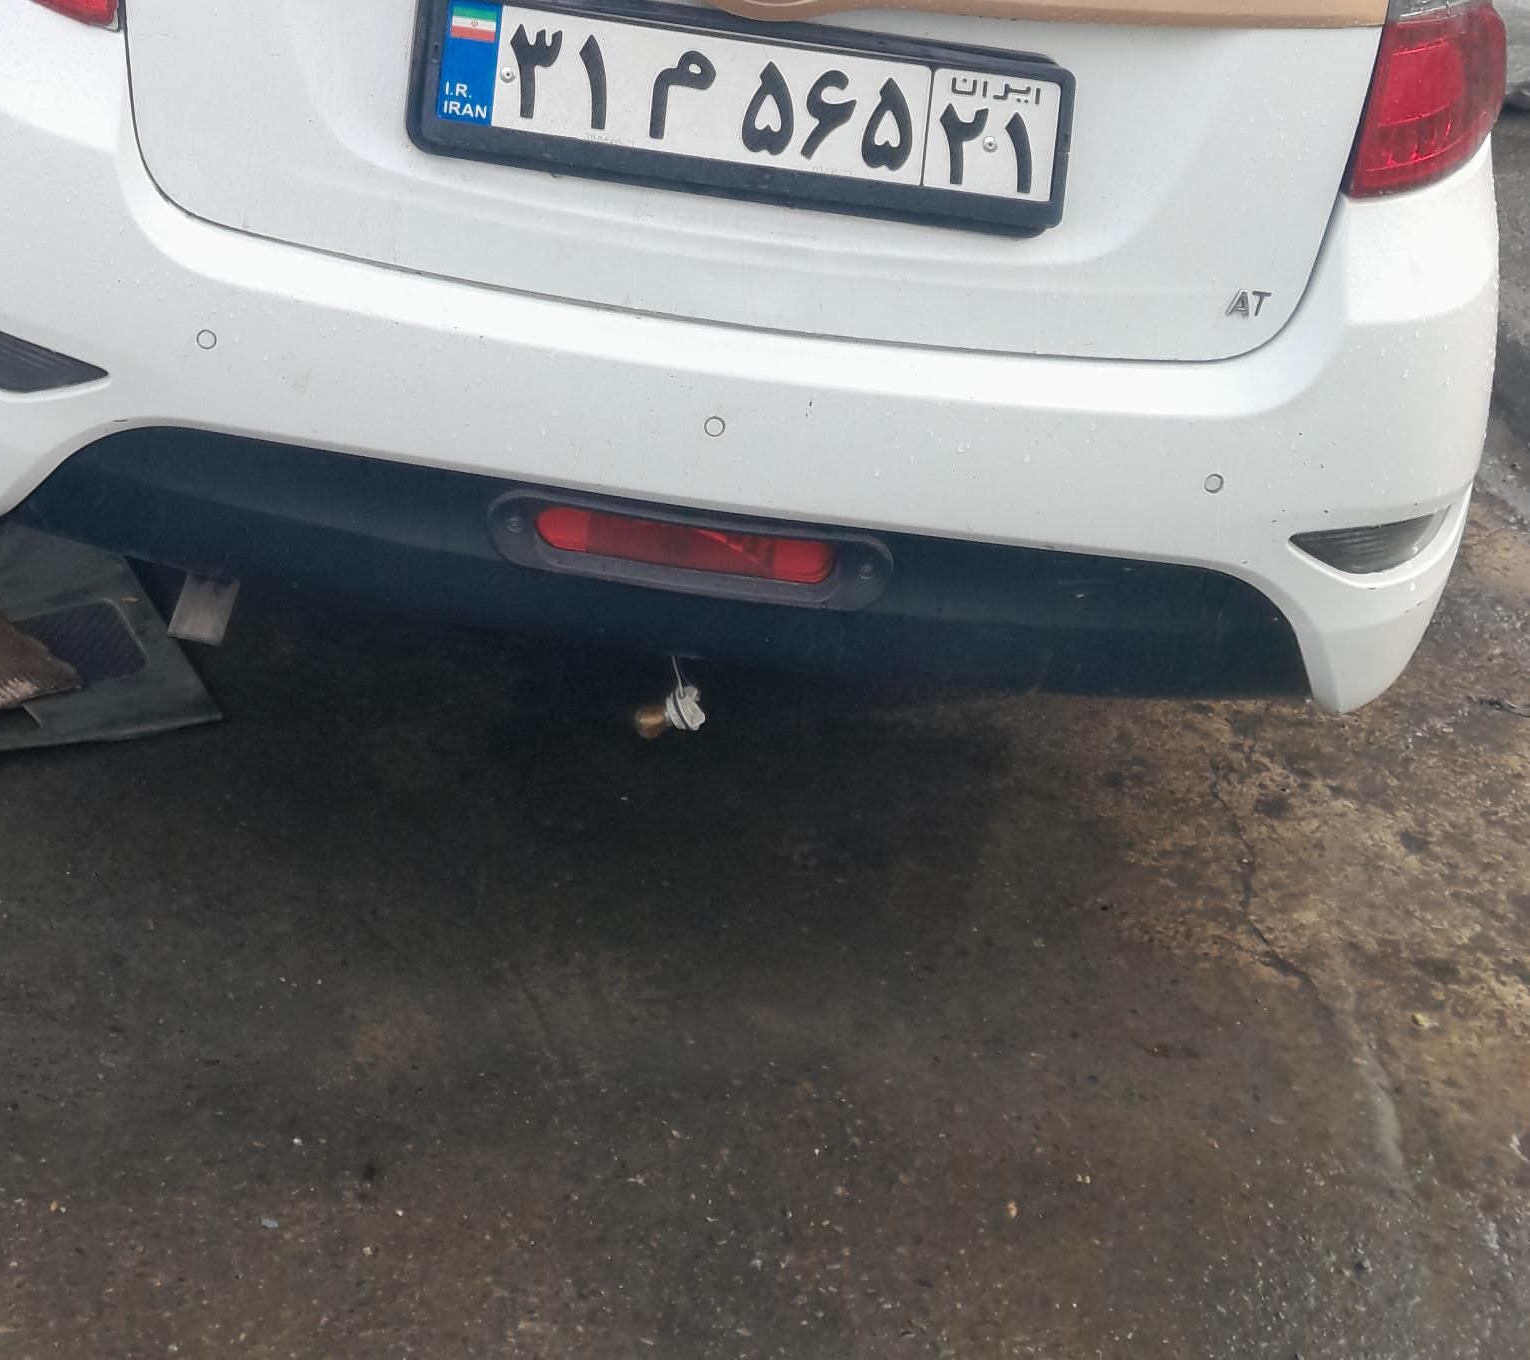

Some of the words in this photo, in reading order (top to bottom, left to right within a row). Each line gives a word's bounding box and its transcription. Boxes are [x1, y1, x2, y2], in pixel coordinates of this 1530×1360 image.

[444, 82, 472, 100] I.R.
[950, 76, 1042, 105] ایران
[442, 98, 488, 119] IRAN
[938, 101, 1034, 195] ۲۱
[1226, 288, 1272, 319] AT
